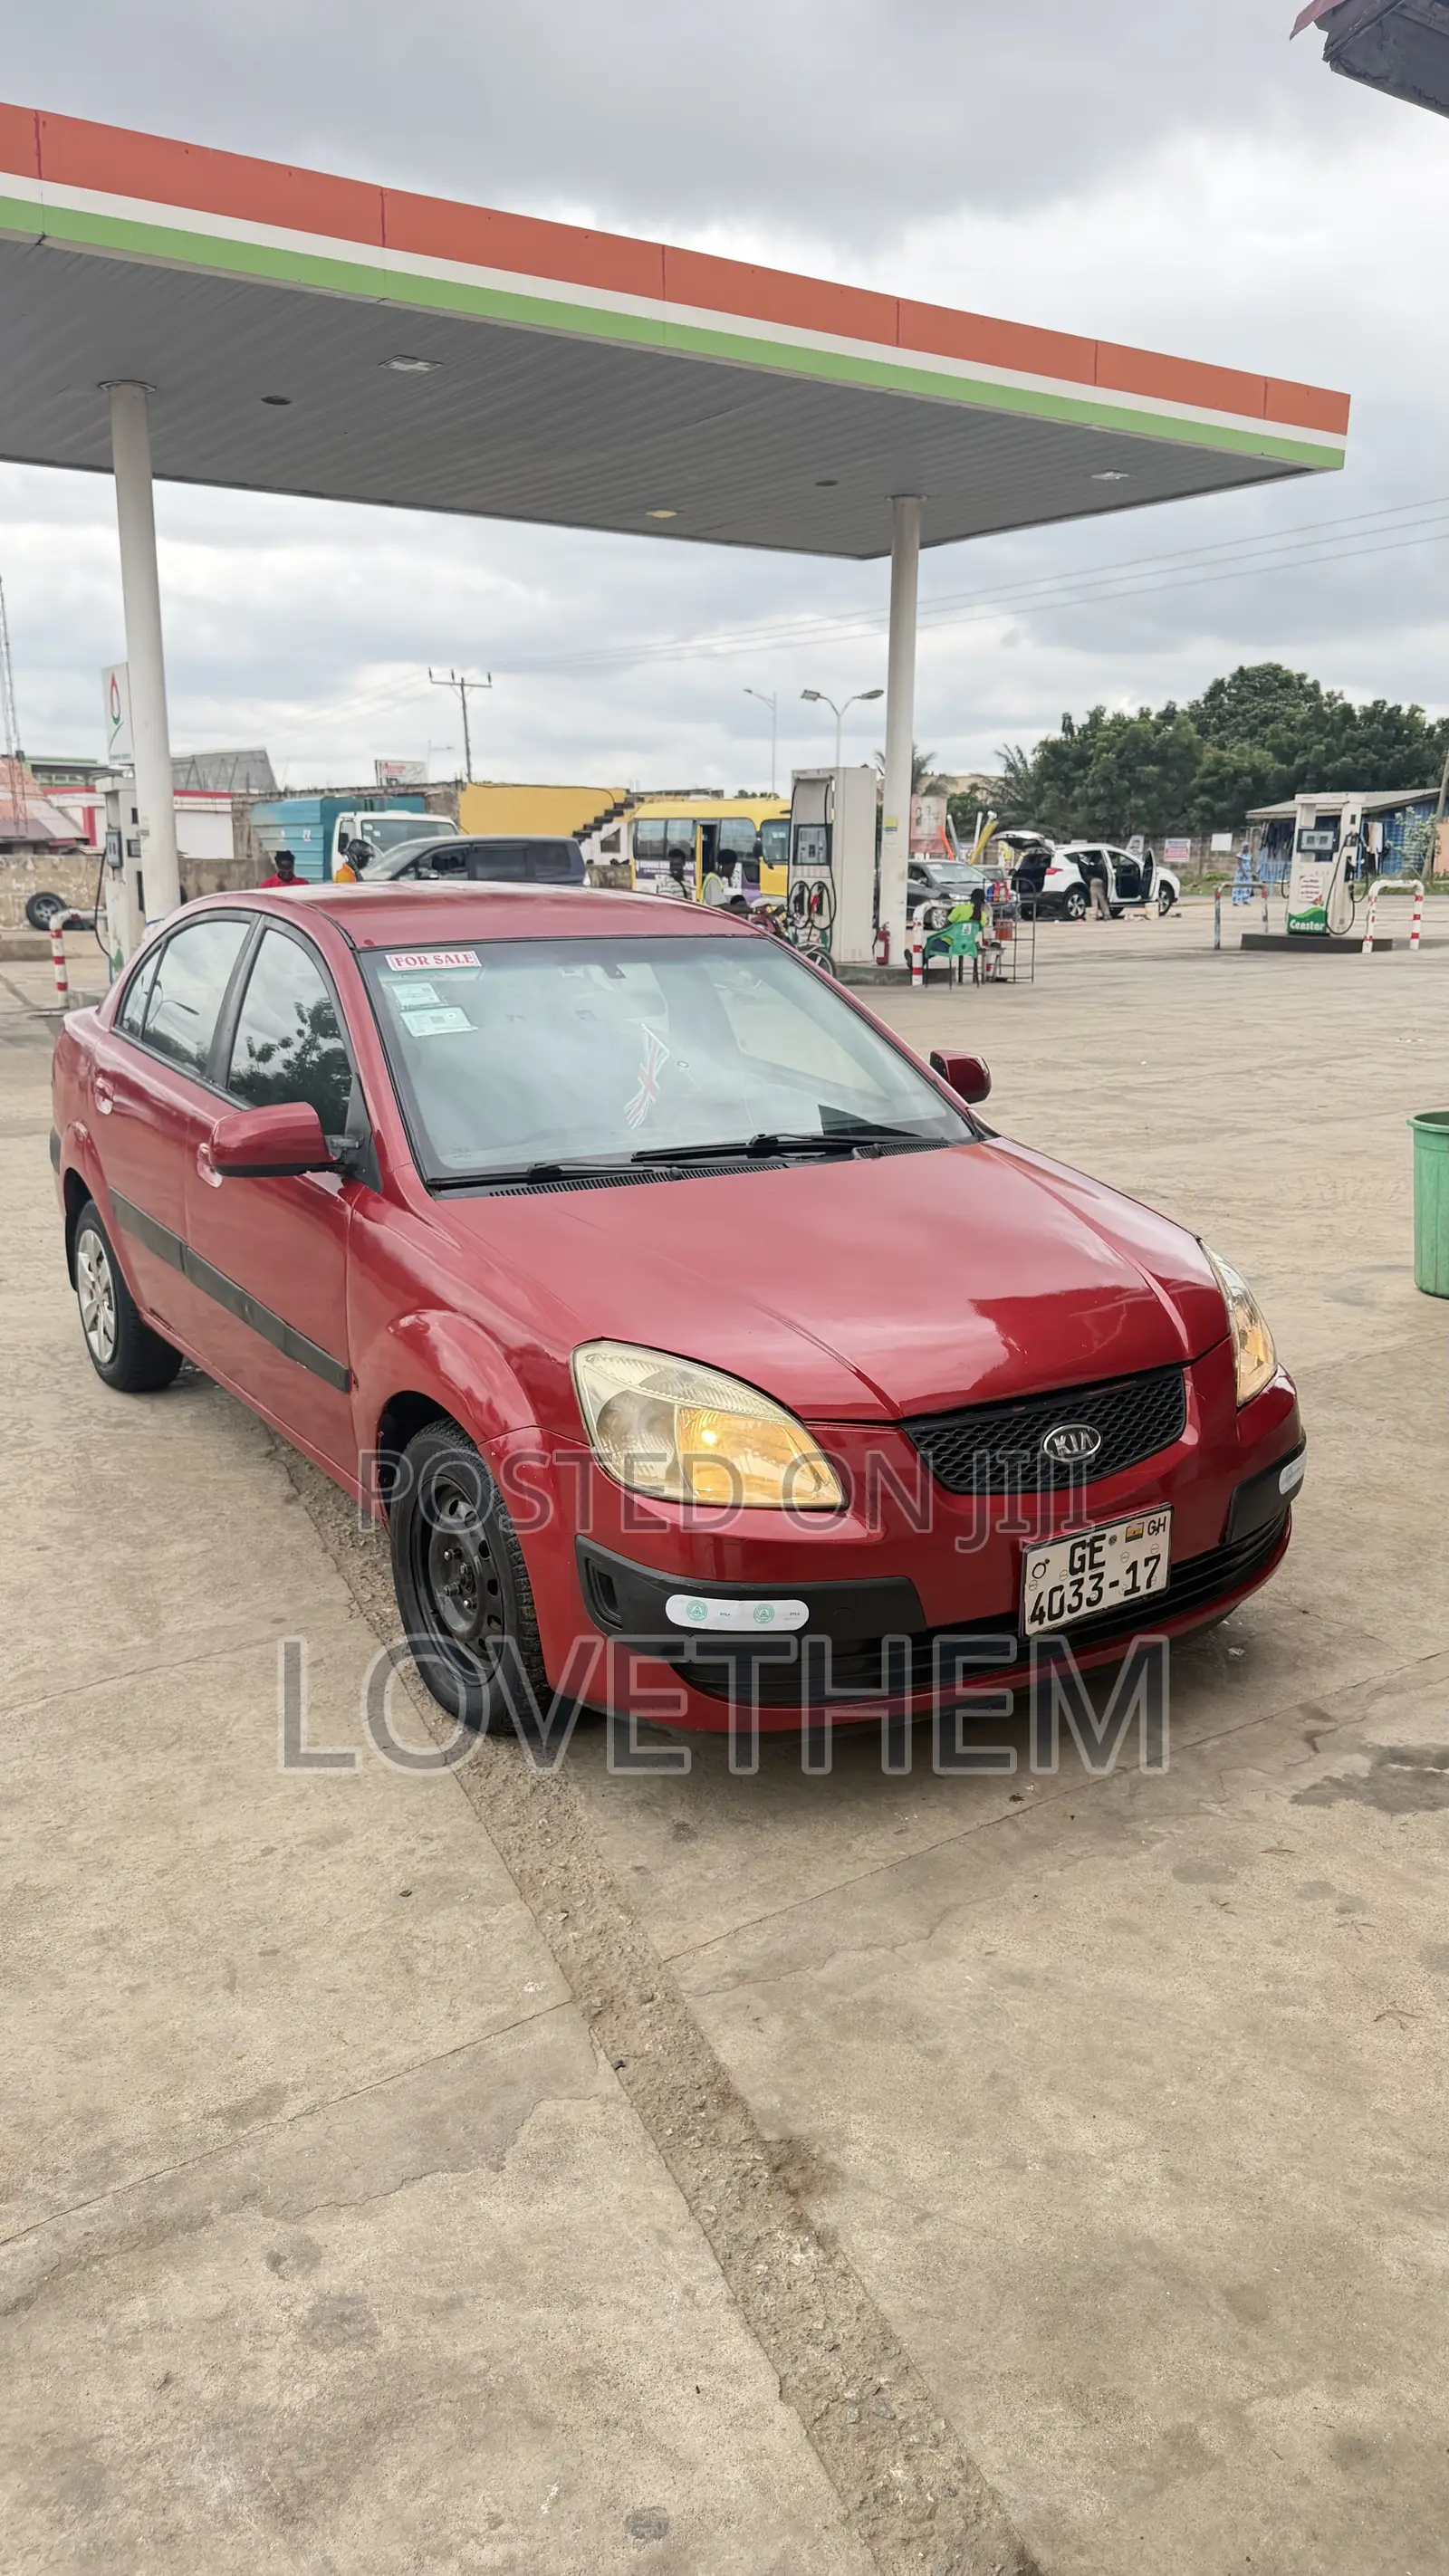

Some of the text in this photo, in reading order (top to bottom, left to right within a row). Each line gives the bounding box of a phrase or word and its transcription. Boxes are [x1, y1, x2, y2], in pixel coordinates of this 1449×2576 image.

[394, 953, 475, 967] FOR SALE
[1052, 1431, 1094, 1456] KIA
[1069, 1516, 1166, 1576] GE GH
[1030, 1553, 1161, 1625] 4033-17
